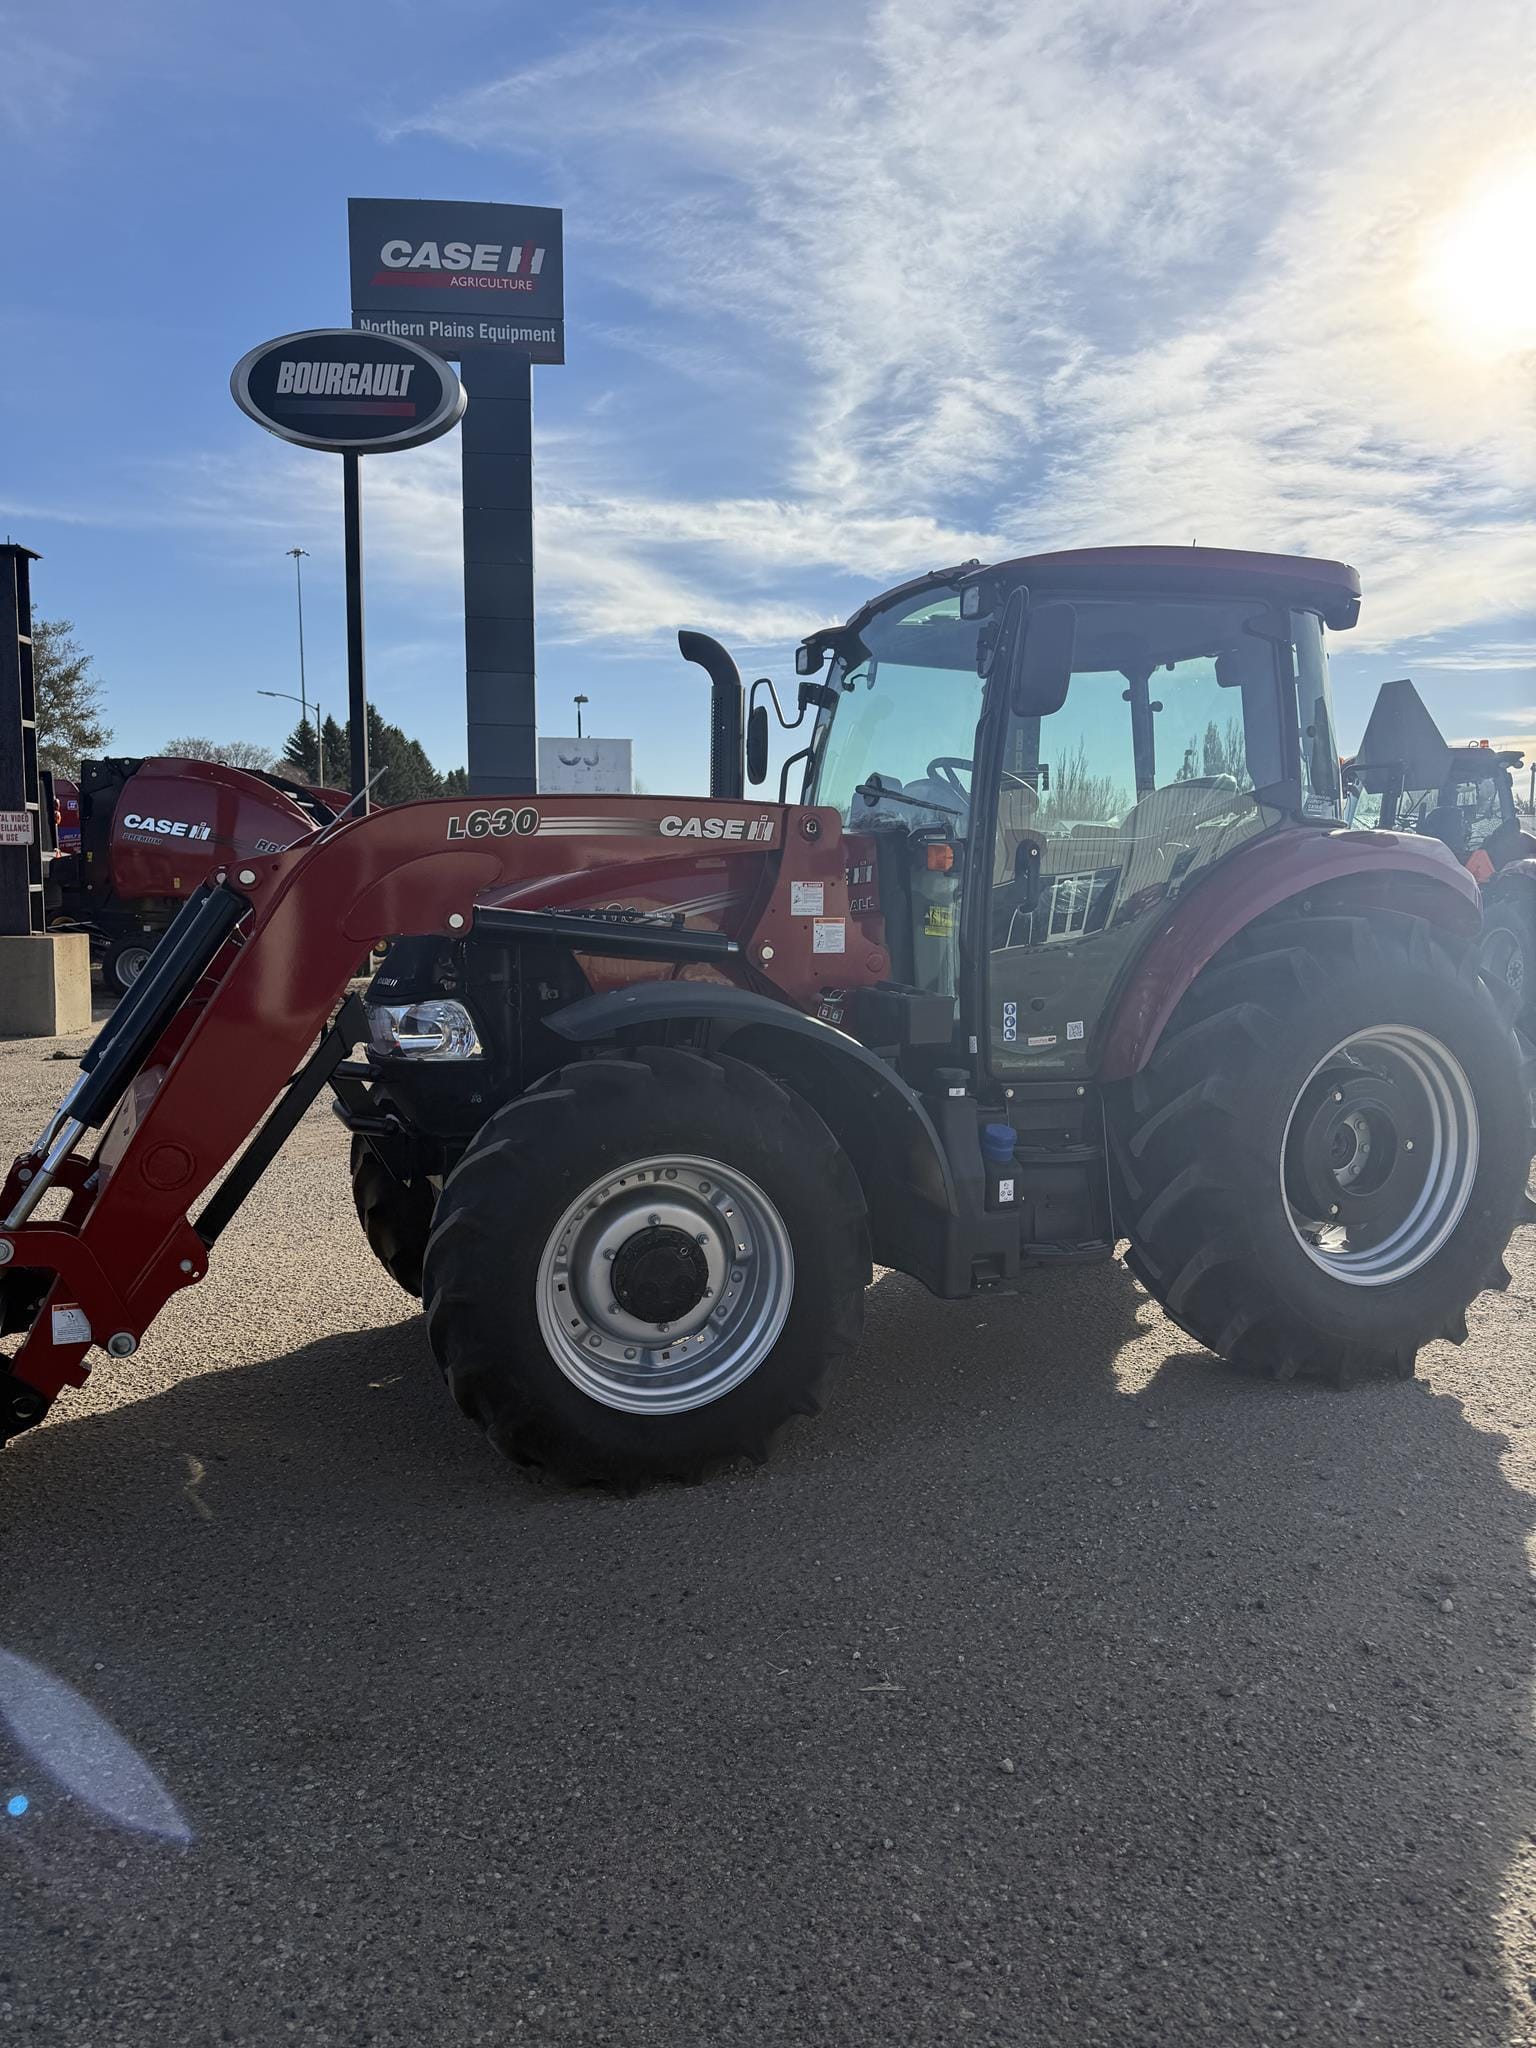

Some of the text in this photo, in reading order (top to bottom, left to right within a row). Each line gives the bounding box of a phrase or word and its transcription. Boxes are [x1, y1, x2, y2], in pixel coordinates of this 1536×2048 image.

[380, 240, 503, 272] CASE
[450, 276, 533, 291] AGRICULTURE
[360, 319, 557, 343] Northern Plains Equipment
[276, 361, 416, 397] BOURGAULT
[0, 824, 30, 833] EILLANCE
[11, 814, 29, 823] VIDEO
[123, 814, 188, 836] CASE
[446, 806, 539, 840] L630
[659, 815, 745, 839] CASE
[6, 833, 19, 841] USE
